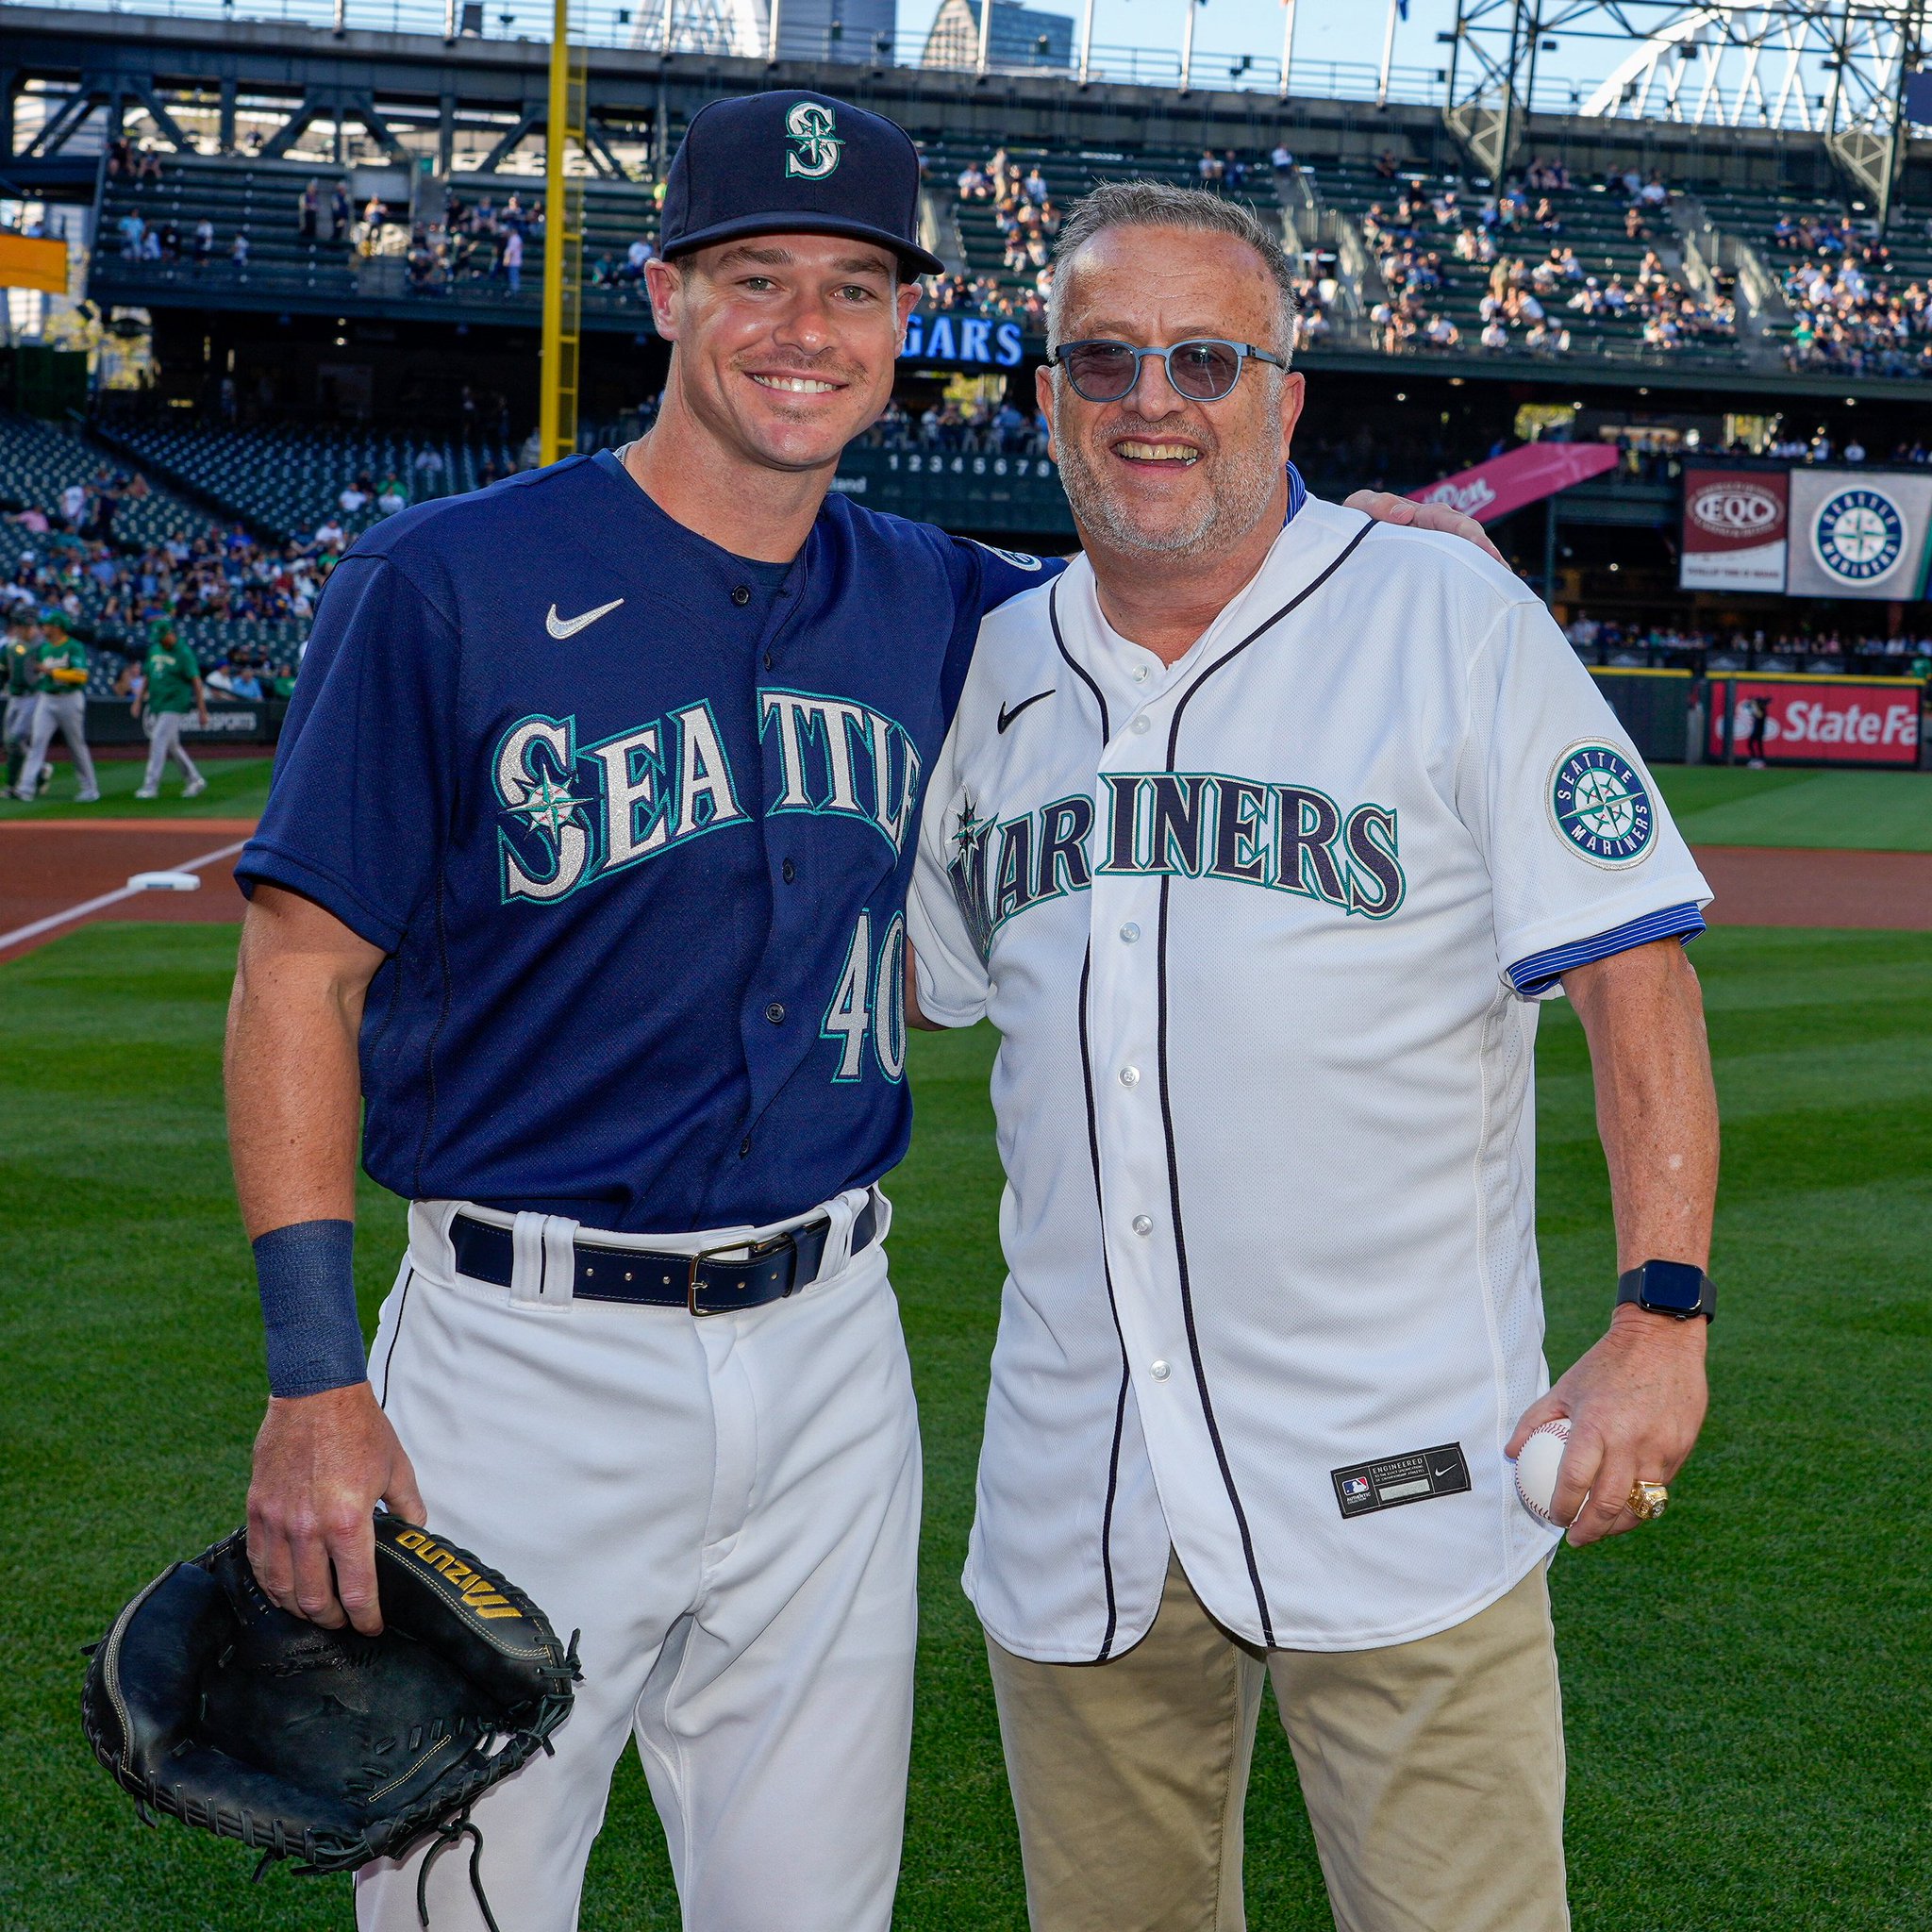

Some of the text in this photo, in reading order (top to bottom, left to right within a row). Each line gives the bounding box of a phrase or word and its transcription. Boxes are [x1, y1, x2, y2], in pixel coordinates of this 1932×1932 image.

[785, 100, 841, 181] S
[829, 475, 867, 493] land
[888, 454, 1051, 477] 1 2 3 4 5 6 7 8
[1694, 493, 1776, 528] EQC
[491, 687, 922, 906] SEATTLE
[1557, 752, 1633, 800] SEATTLE
[1571, 804, 1649, 856] MARINERS
[947, 772, 1406, 960] MARINERS
[820, 908, 908, 1084] 40
[1373, 1457, 1424, 1474] ENGINEERED
